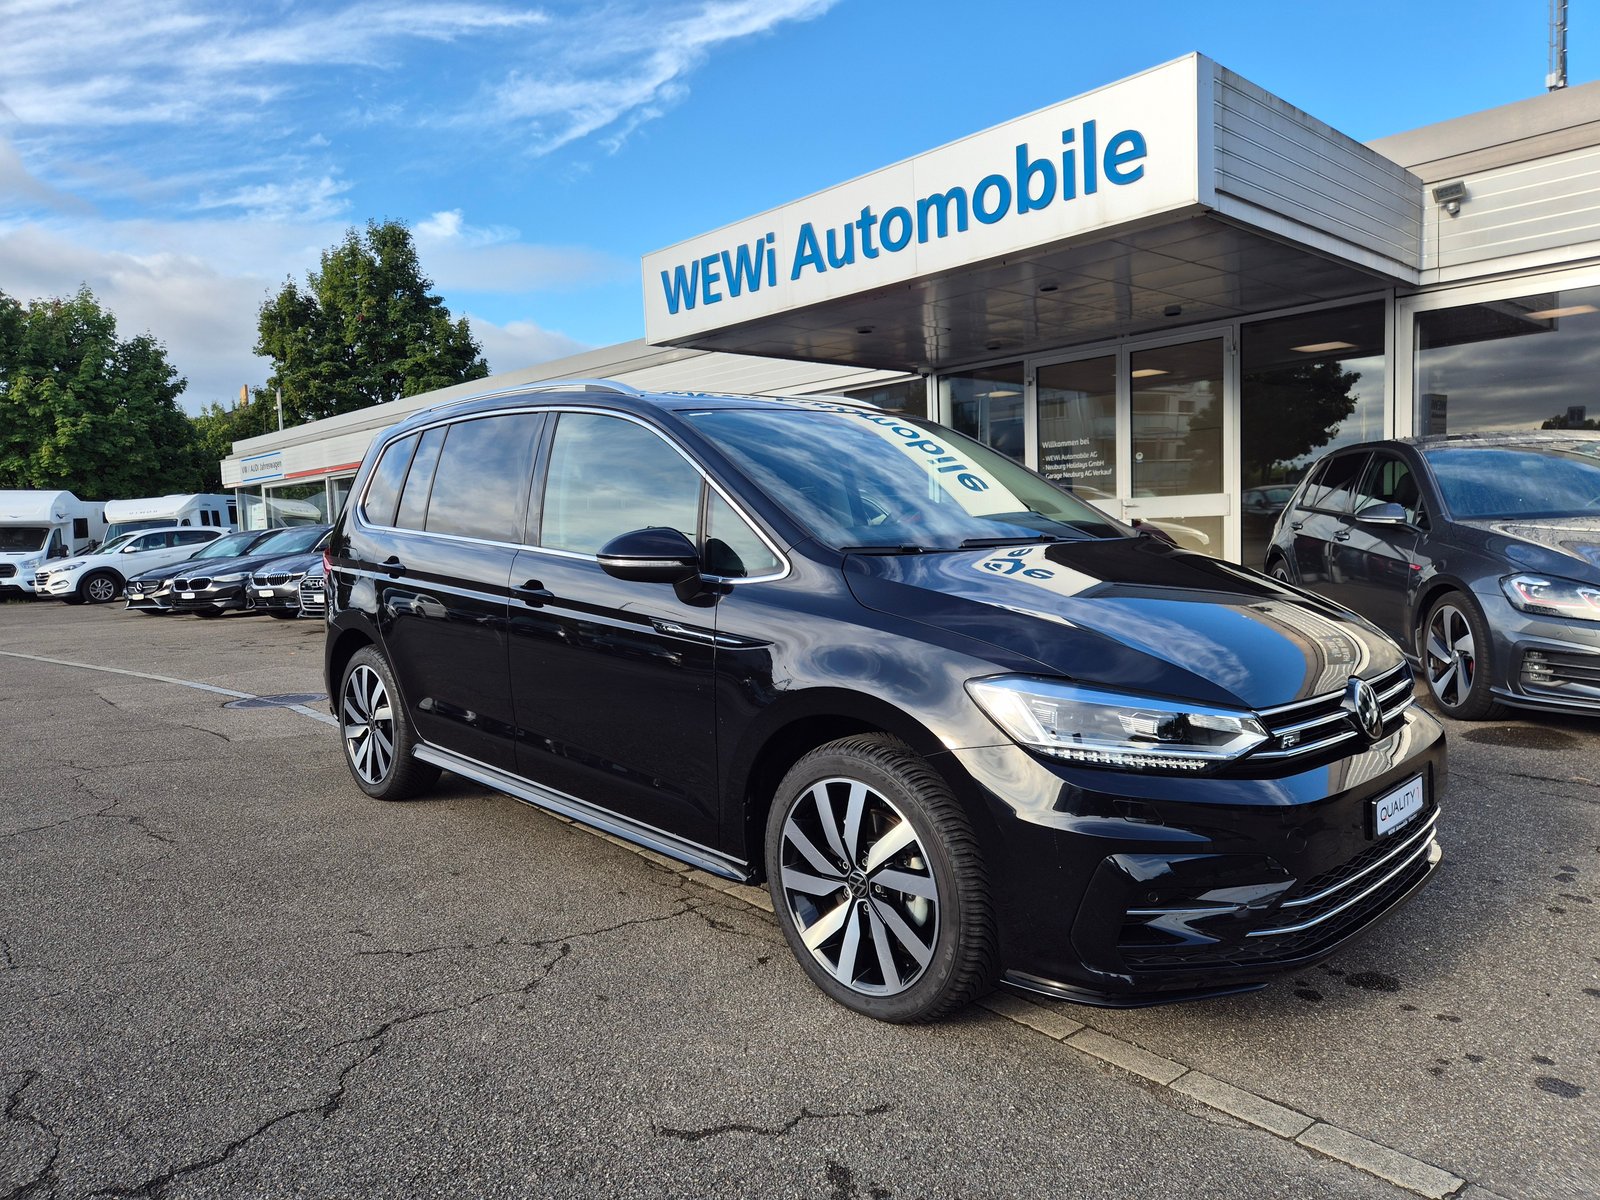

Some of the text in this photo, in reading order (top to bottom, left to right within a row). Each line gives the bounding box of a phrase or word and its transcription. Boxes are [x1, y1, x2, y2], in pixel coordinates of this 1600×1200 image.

[660, 119, 1147, 315] WEWi Automobile
[1041, 437, 1090, 449] Willkommen bei
[1062, 452, 1089, 460] Automobile
[1045, 463, 1066, 471] Neuburg
[1066, 461, 1088, 470] Holidays
[1063, 470, 1084, 479] Neuburg
[1085, 469, 1093, 477] AG
[1093, 468, 1112, 477] Verkauf
